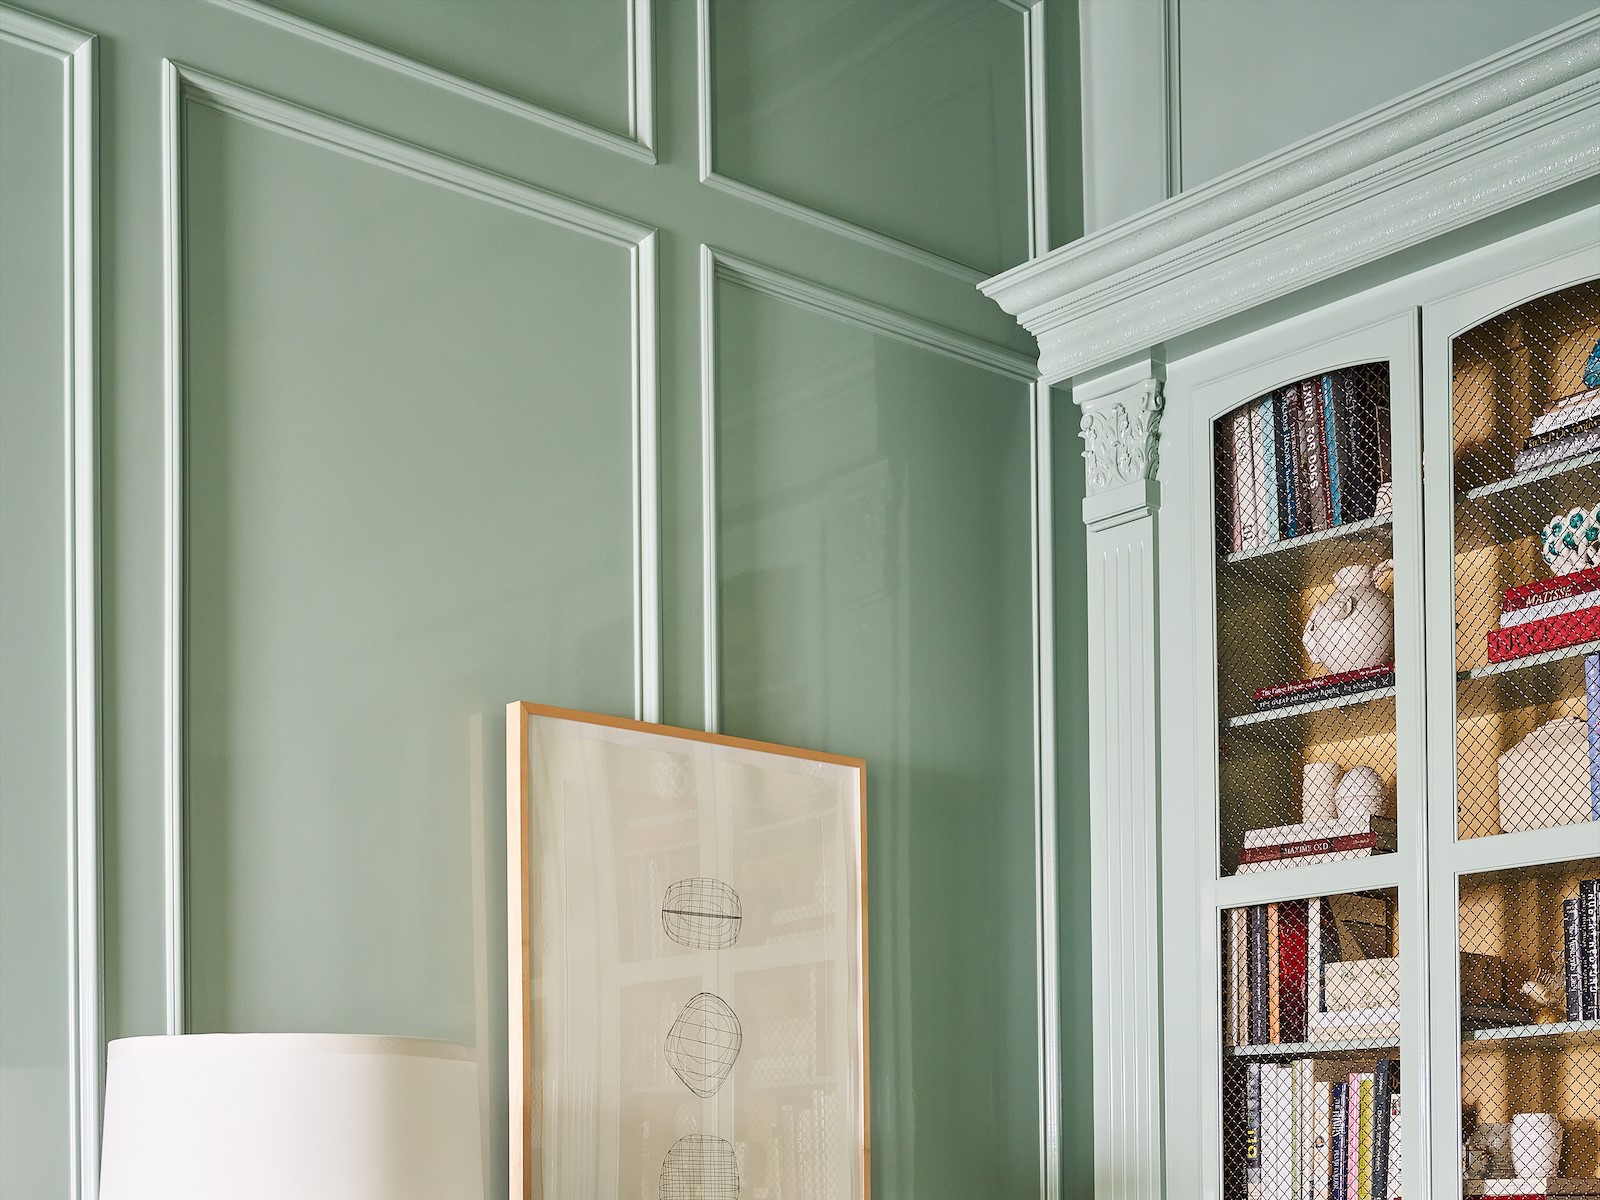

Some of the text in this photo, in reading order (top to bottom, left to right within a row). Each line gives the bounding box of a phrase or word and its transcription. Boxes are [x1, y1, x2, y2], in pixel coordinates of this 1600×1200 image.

[1305, 427, 1316, 452] FOR
[1308, 456, 1319, 490] DOGS
[1526, 585, 1573, 606] MATISSE
